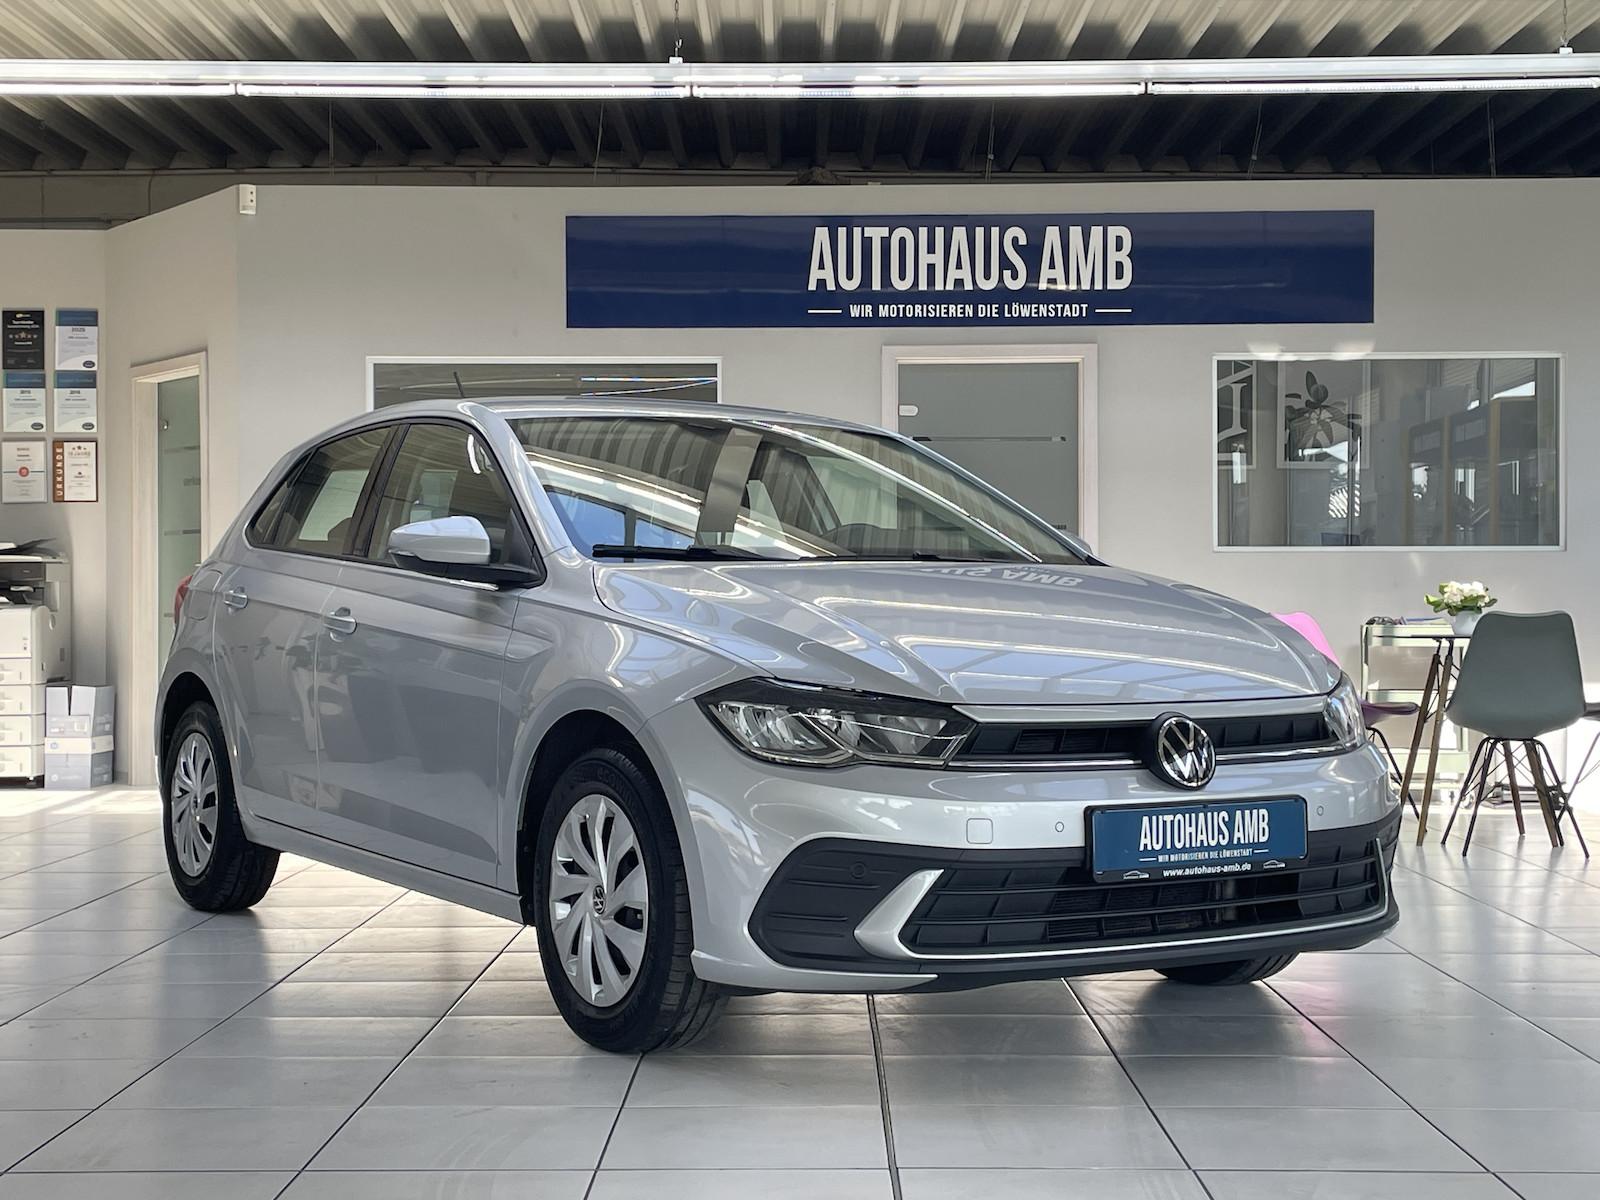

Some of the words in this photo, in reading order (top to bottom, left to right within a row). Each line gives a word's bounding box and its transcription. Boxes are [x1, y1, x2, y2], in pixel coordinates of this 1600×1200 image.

[807, 226, 1028, 292] AUTOHAUS
[1037, 225, 1133, 291] AMB
[849, 304, 873, 318] WIR
[878, 304, 974, 318] MOTORISIEREN
[977, 304, 1000, 318] DIE
[1004, 302, 1089, 318] LÖWENSTADT
[1139, 810, 1229, 851] AUTOHAUS
[1233, 808, 1270, 845] AMB
[1162, 862, 1252, 877] www.autohaus-amb.de
